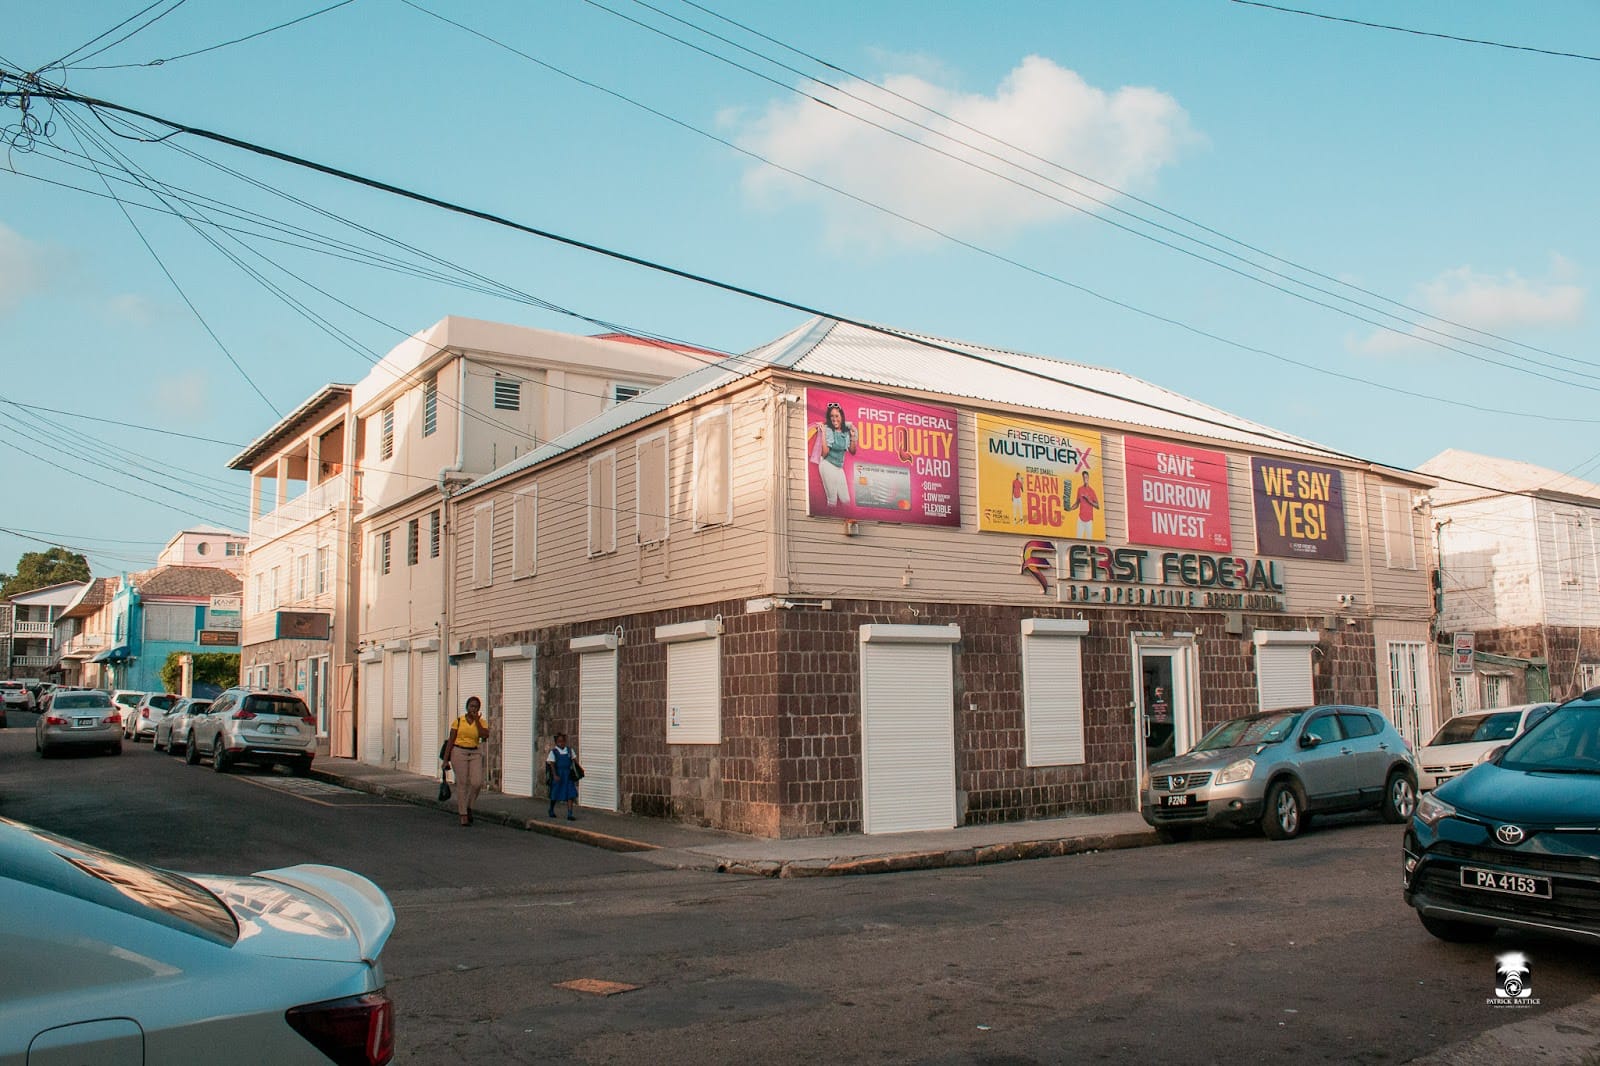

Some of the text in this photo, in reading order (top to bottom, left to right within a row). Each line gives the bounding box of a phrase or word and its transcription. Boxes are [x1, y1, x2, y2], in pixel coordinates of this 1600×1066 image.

[858, 407, 953, 430] FIRST FEDERAL
[1032, 433, 1073, 448] FEDERAL
[916, 457, 951, 478] CARD
[1156, 452, 1196, 478] SAVE
[1026, 474, 1059, 494] EARN
[1142, 479, 1211, 510] BORROW
[1261, 466, 1331, 501] WE SAY
[924, 491, 938, 502] LOW
[924, 502, 952, 514] FLEXIBLE
[1151, 511, 1206, 539] INVEST
[1272, 500, 1328, 541] YES!
[1161, 552, 1283, 591] FEDERAL
[1204, 591, 1243, 609] CREDIT
[1477, 871, 1536, 893] PA 4153
